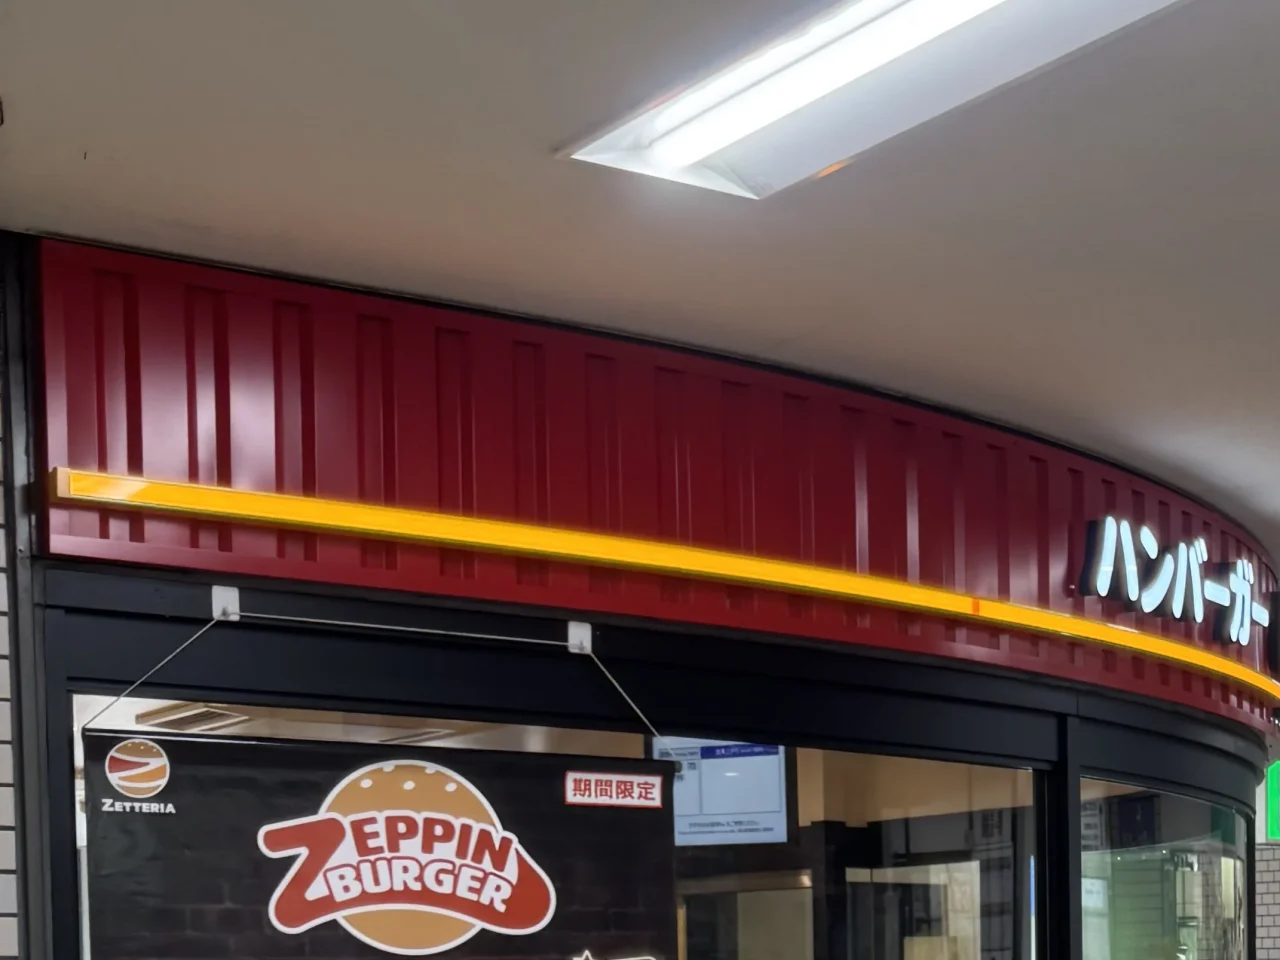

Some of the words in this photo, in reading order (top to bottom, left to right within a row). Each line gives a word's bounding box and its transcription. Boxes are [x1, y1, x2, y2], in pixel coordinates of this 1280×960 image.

[1096, 515, 1269, 646] ハンバーガー
[101, 798, 176, 814] ZETTERIA
[572, 777, 656, 801] 期間限定
[258, 810, 518, 934] ZEPPIN
[324, 857, 513, 913] BURGER
